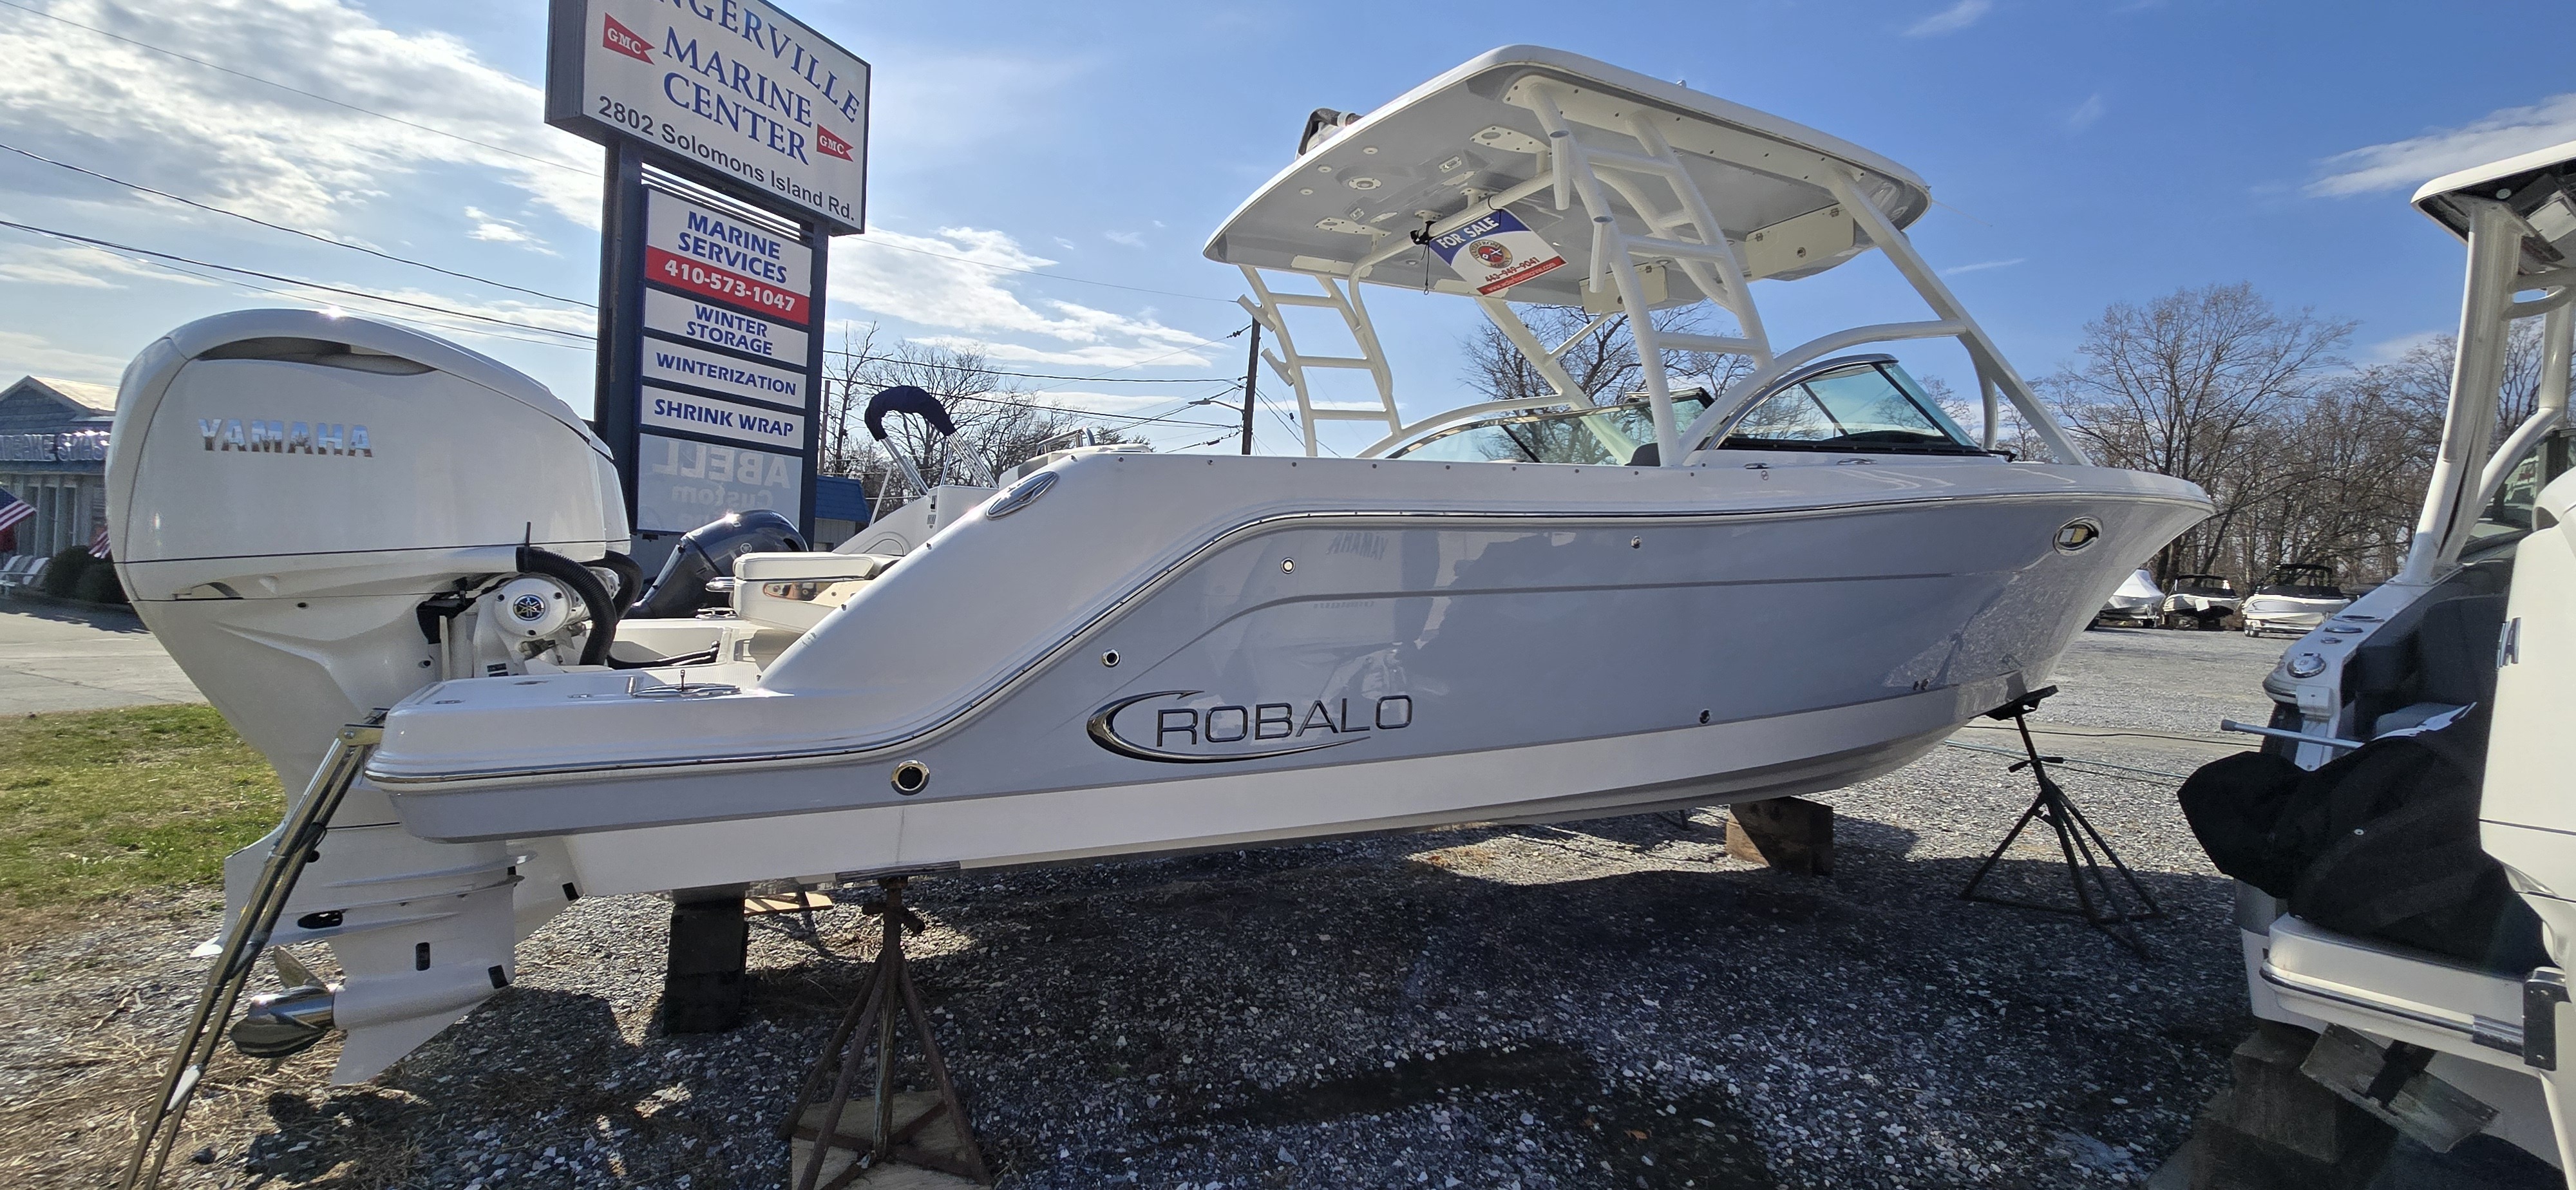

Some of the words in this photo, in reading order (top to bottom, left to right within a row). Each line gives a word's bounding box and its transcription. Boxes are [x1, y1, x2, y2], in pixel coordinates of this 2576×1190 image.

[607, 27, 641, 55] GMC
[658, 0, 860, 123] GERVILLE
[663, 26, 812, 128] MARINE
[664, 72, 809, 165] CENTER
[599, 96, 653, 137] 2802
[661, 124, 764, 182] Solomons
[772, 171, 822, 208] Island
[828, 194, 855, 221] Rd.
[819, 135, 844, 155] GMC
[687, 211, 781, 260] MARINE
[1436, 232, 1466, 249] FOR
[1464, 217, 1499, 238] SALE
[678, 232, 787, 283] SERVICES
[1484, 256, 1540, 283] 443-949-9041
[665, 260, 795, 312] 410-573-1047
[686, 321, 773, 355] STORAGE
[694, 304, 768, 337] WINTER
[656, 352, 797, 395] WINTERIZATION
[198, 418, 374, 458] YAMAHA
[654, 399, 733, 427] SHRINK
[739, 413, 794, 437] WRAP
[1157, 695, 1413, 747] ROBALO
